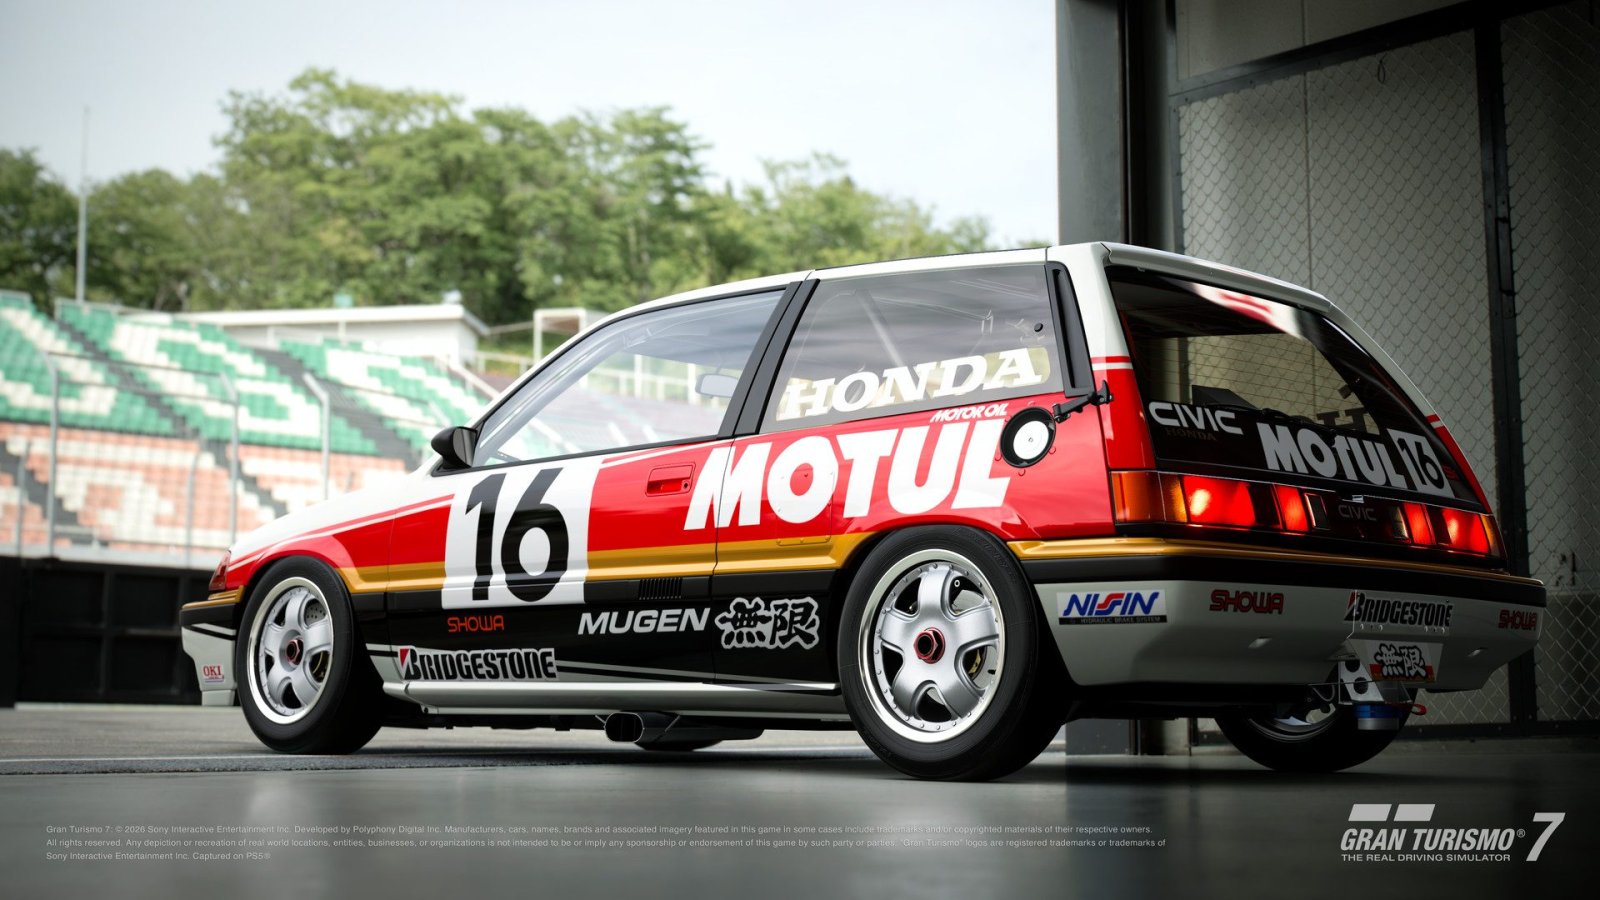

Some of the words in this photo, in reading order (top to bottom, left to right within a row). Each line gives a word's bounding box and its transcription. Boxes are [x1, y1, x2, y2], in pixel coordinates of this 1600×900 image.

[776, 347, 1043, 421] HONDA
[930, 405, 985, 423] MOTOR
[984, 402, 1009, 418] OIL
[1149, 401, 1244, 435] CIVIC
[1165, 428, 1217, 441] HONDA
[683, 419, 1011, 530] MOTUL
[1397, 437, 1445, 489] 16
[1338, 504, 1377, 522] CIVIC
[465, 467, 569, 602] 16
[1209, 589, 1285, 614] SHOWA
[1344, 591, 1453, 627] BRIDGESTONE
[447, 615, 505, 632] SHOWA
[577, 607, 711, 635] MUGEN
[714, 597, 819, 649] 無限
[1498, 609, 1537, 631] SHOWA
[203, 665, 222, 677] OKI
[400, 648, 557, 681] BRIDGESTONE
[1374, 643, 1427, 678] 無限
